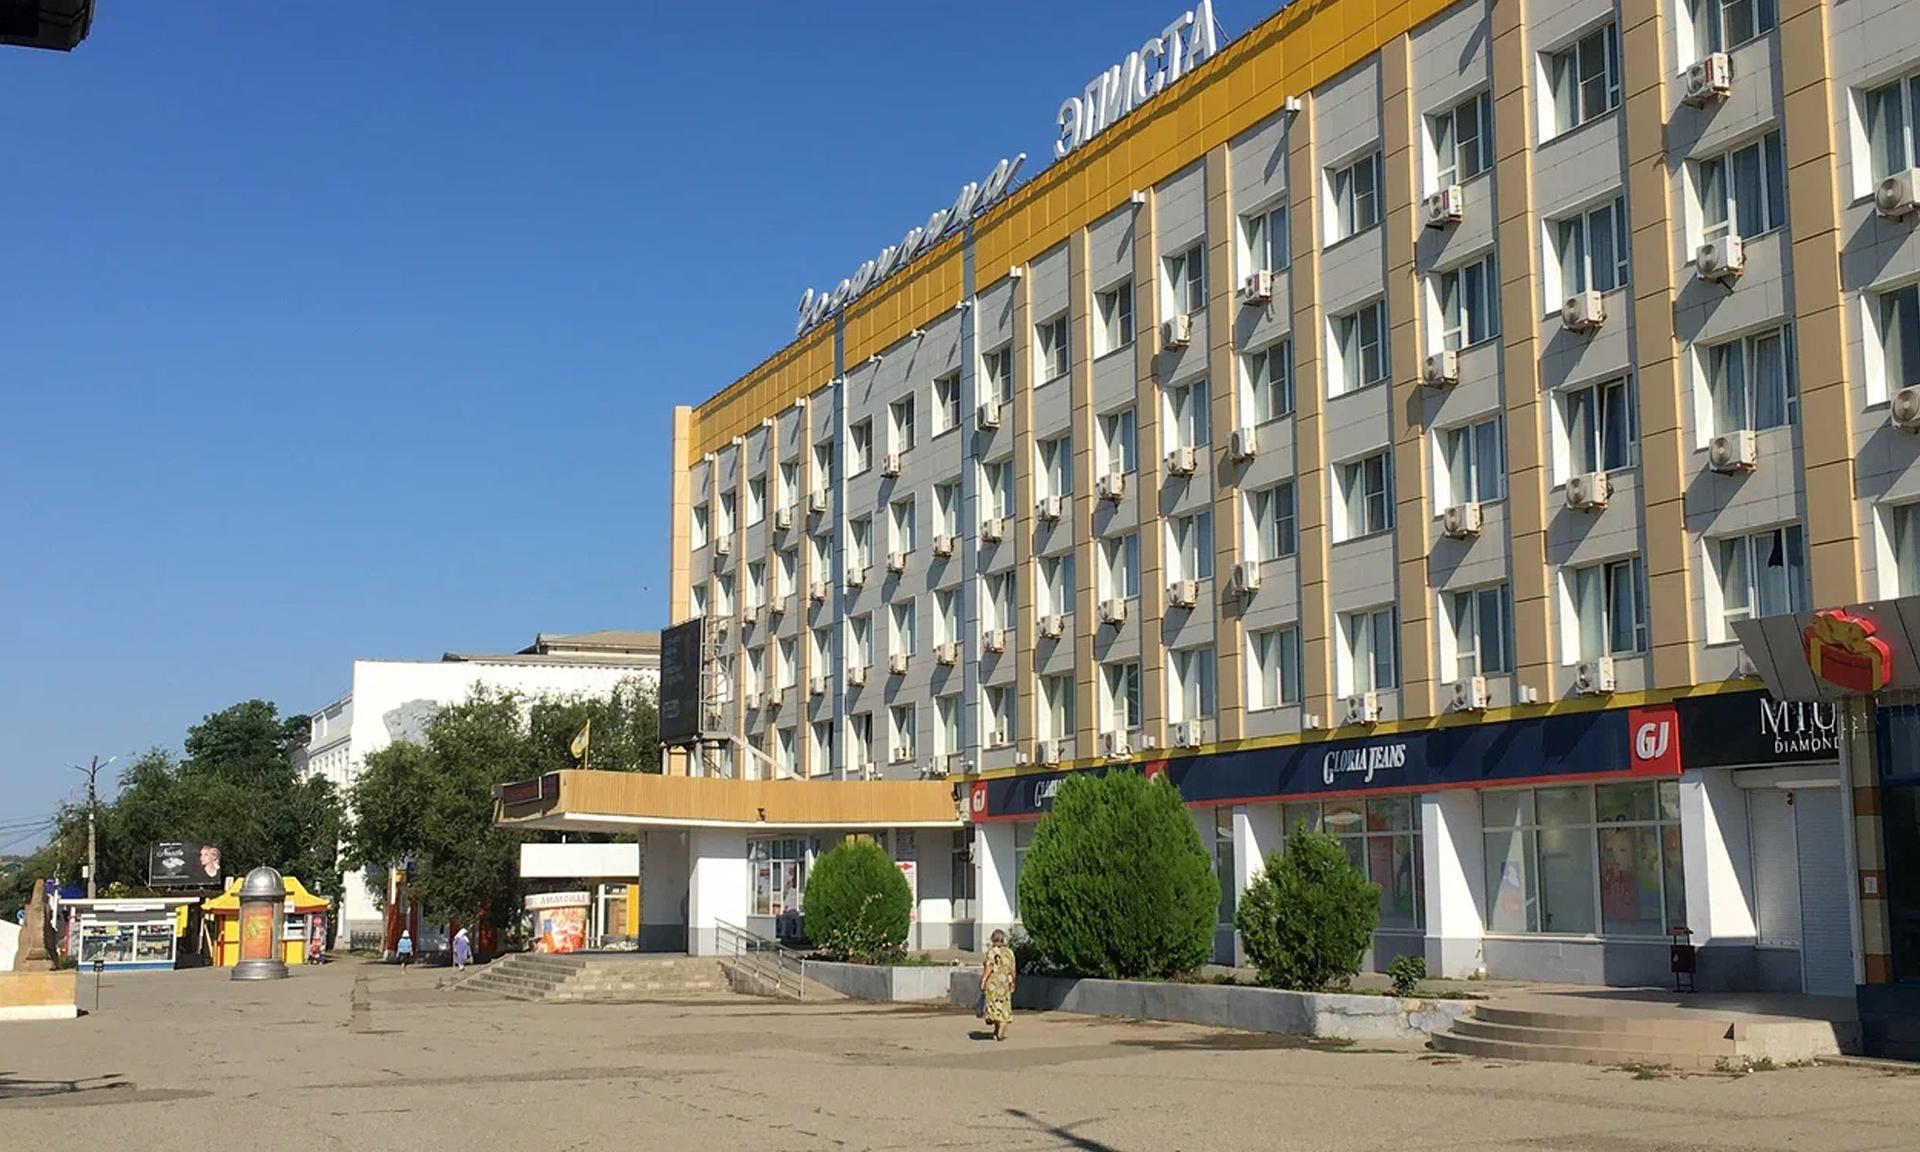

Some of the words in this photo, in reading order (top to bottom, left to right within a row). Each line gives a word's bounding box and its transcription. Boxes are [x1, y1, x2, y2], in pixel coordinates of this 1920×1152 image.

[1636, 721, 1670, 760] GJ
[1323, 748, 1367, 784] GLORIA
[1364, 744, 1406, 782] JEANS
[973, 789, 986, 812] GJ
